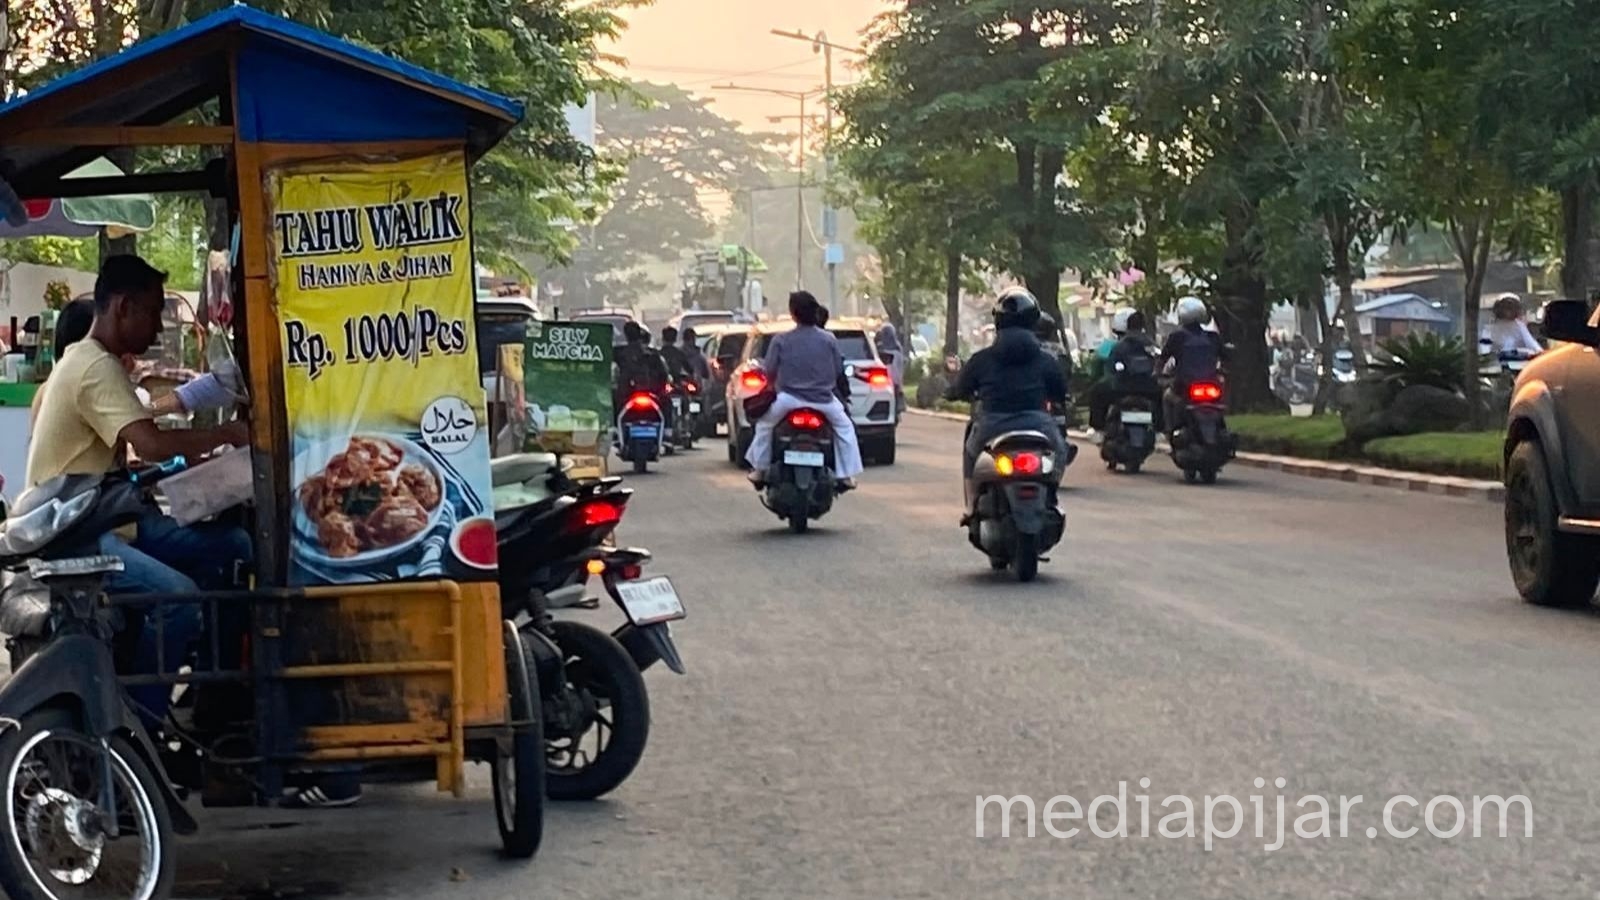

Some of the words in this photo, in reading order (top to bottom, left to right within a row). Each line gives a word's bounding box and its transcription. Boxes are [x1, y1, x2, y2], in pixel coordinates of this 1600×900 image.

[276, 207, 361, 256] TAHU
[366, 195, 464, 249] WALIK
[298, 263, 375, 290] HANIYA
[378, 261, 393, 281] &
[395, 254, 453, 281] JIHAN
[285, 320, 335, 380] Rp.
[532, 343, 604, 361] MATCHA
[423, 406, 475, 434] حلال
[431, 433, 469, 444] HALAL
